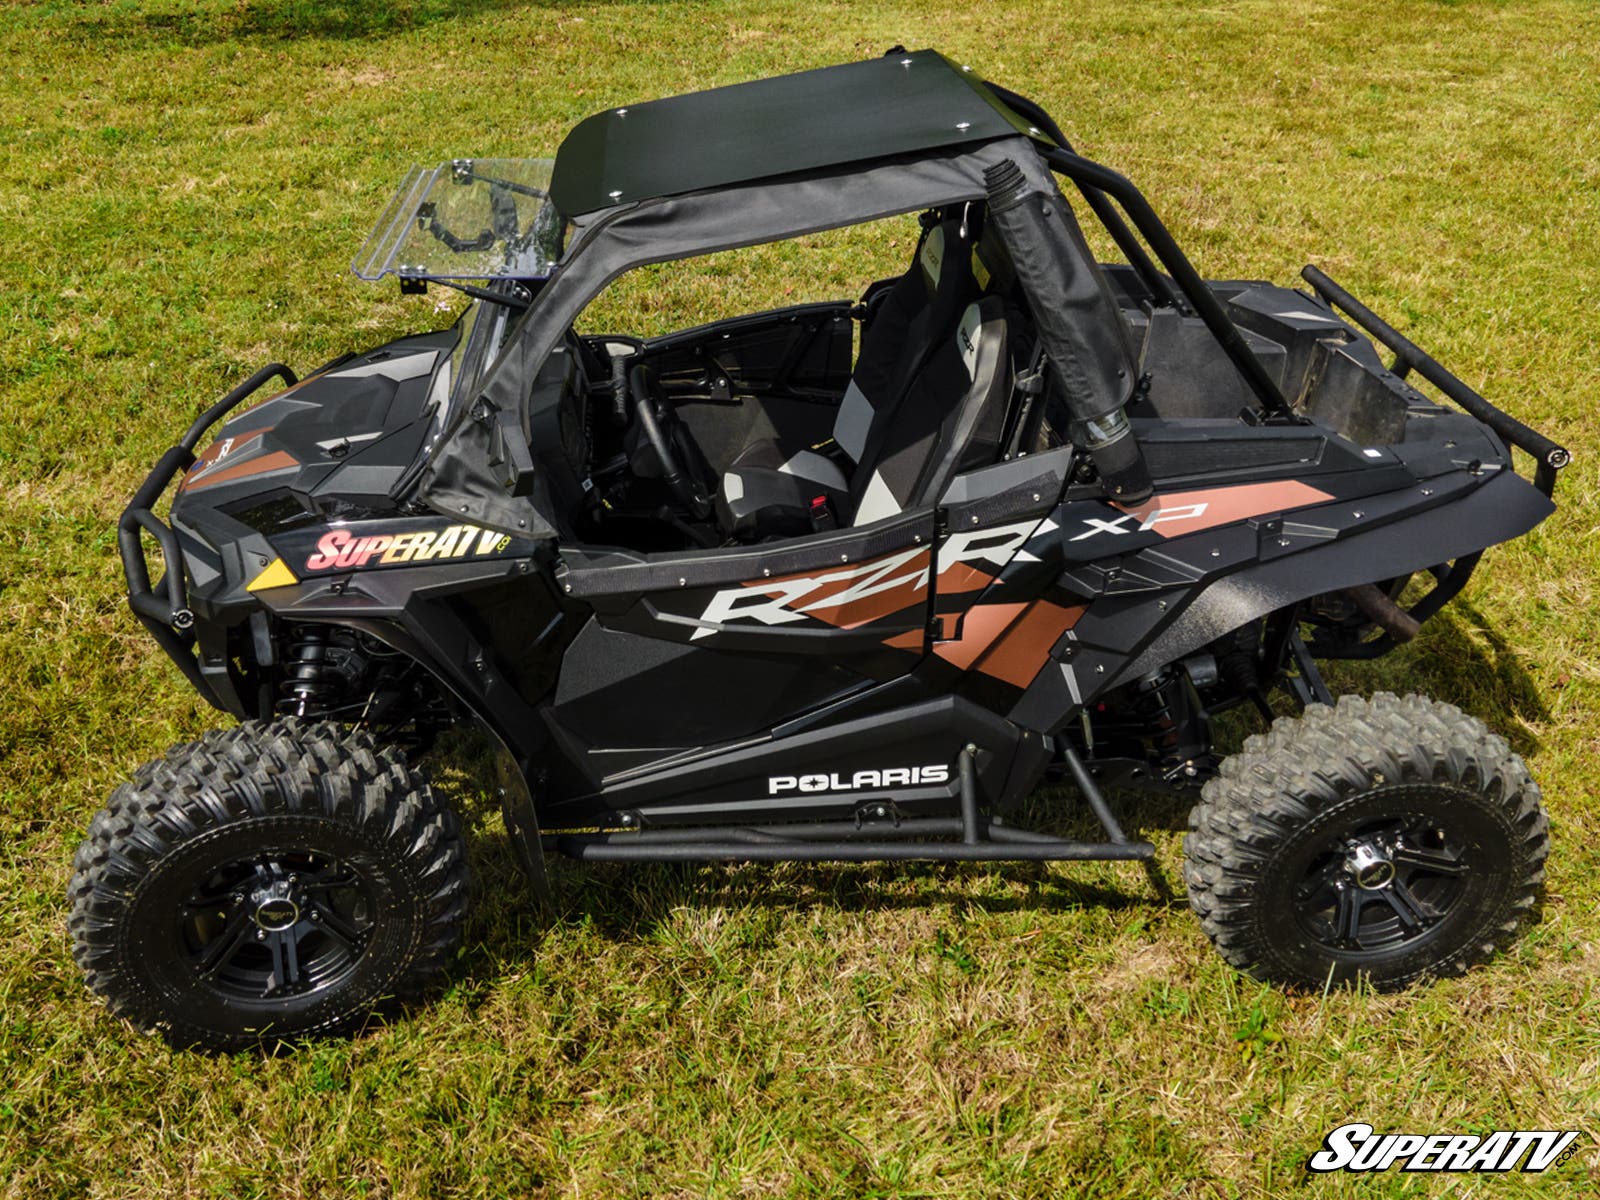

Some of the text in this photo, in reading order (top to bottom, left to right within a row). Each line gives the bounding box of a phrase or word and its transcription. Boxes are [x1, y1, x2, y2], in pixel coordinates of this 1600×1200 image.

[307, 525, 505, 570] SUPERATV
[689, 502, 1209, 641] RZR XP
[768, 764, 949, 794] POLARIS
